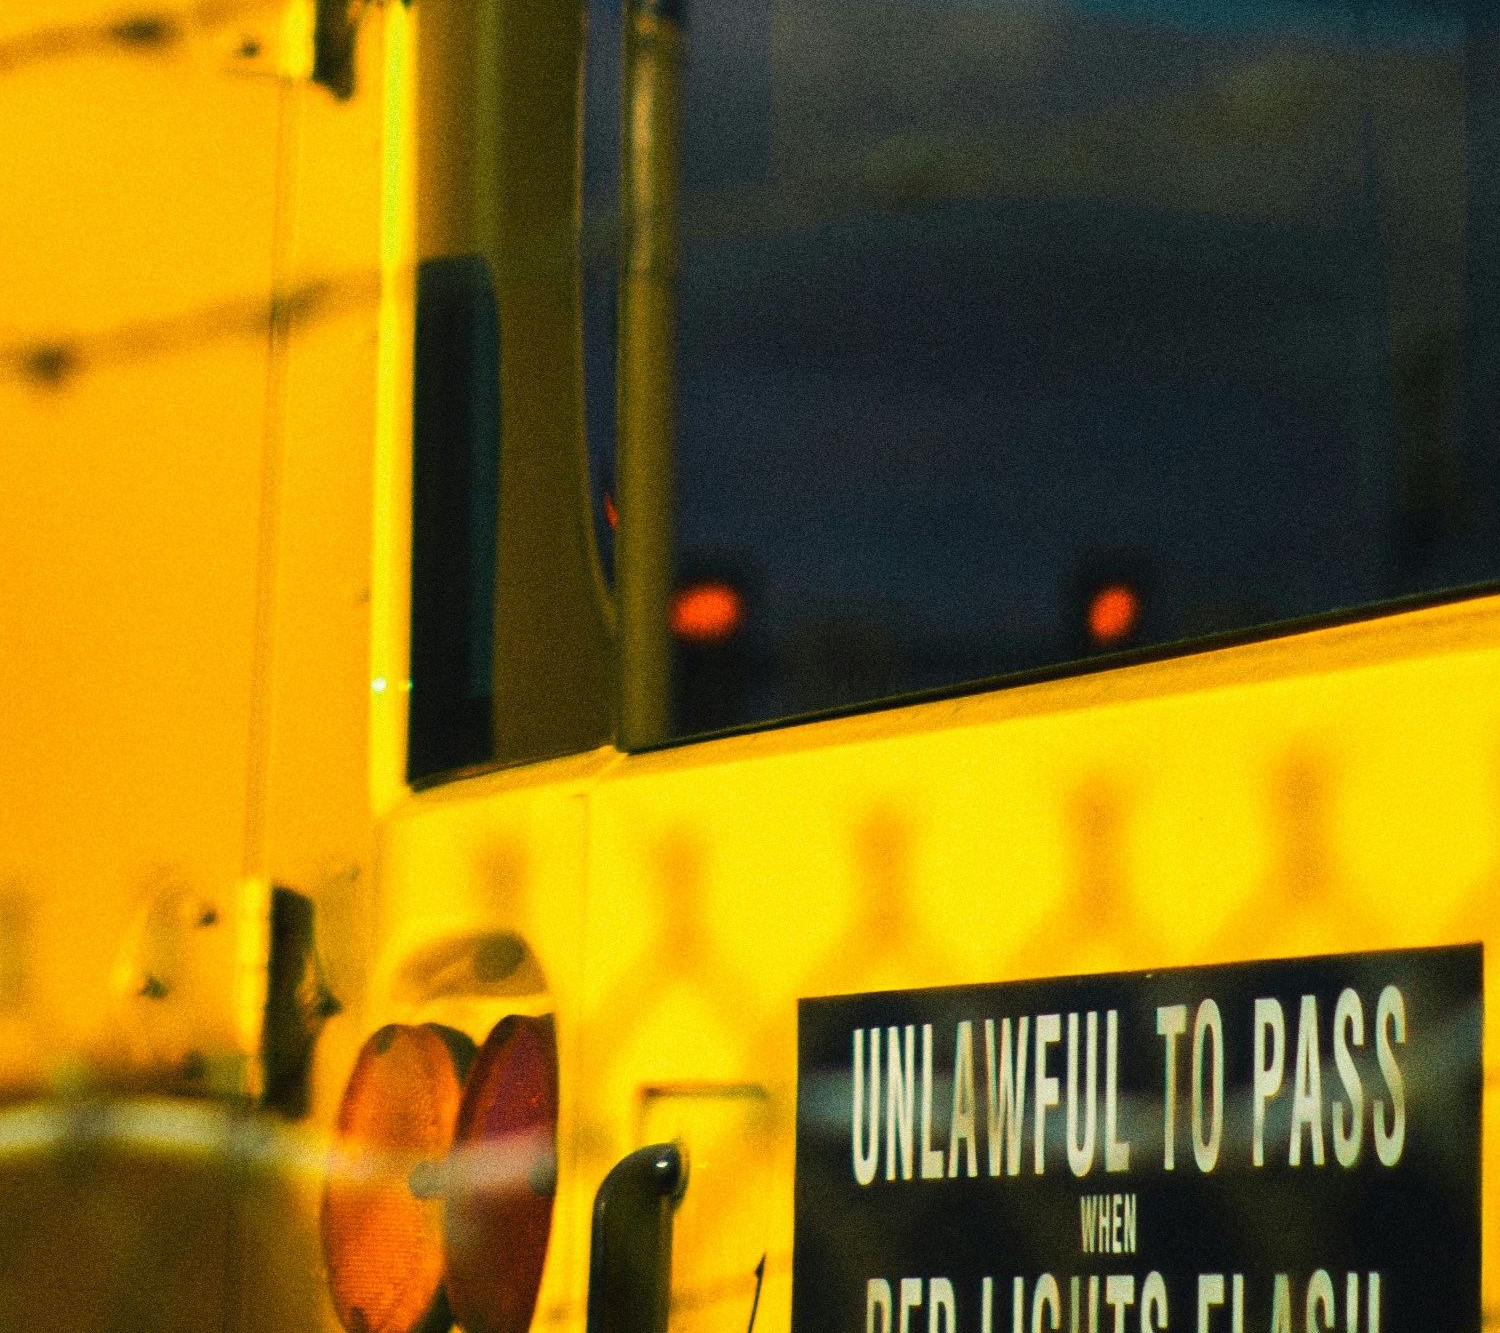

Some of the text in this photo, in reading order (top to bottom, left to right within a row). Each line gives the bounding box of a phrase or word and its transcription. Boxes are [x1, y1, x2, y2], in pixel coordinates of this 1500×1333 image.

[851, 984, 1407, 1186] UNLAWFUL TO PASS
[1079, 1193, 1138, 1254] WHEN
